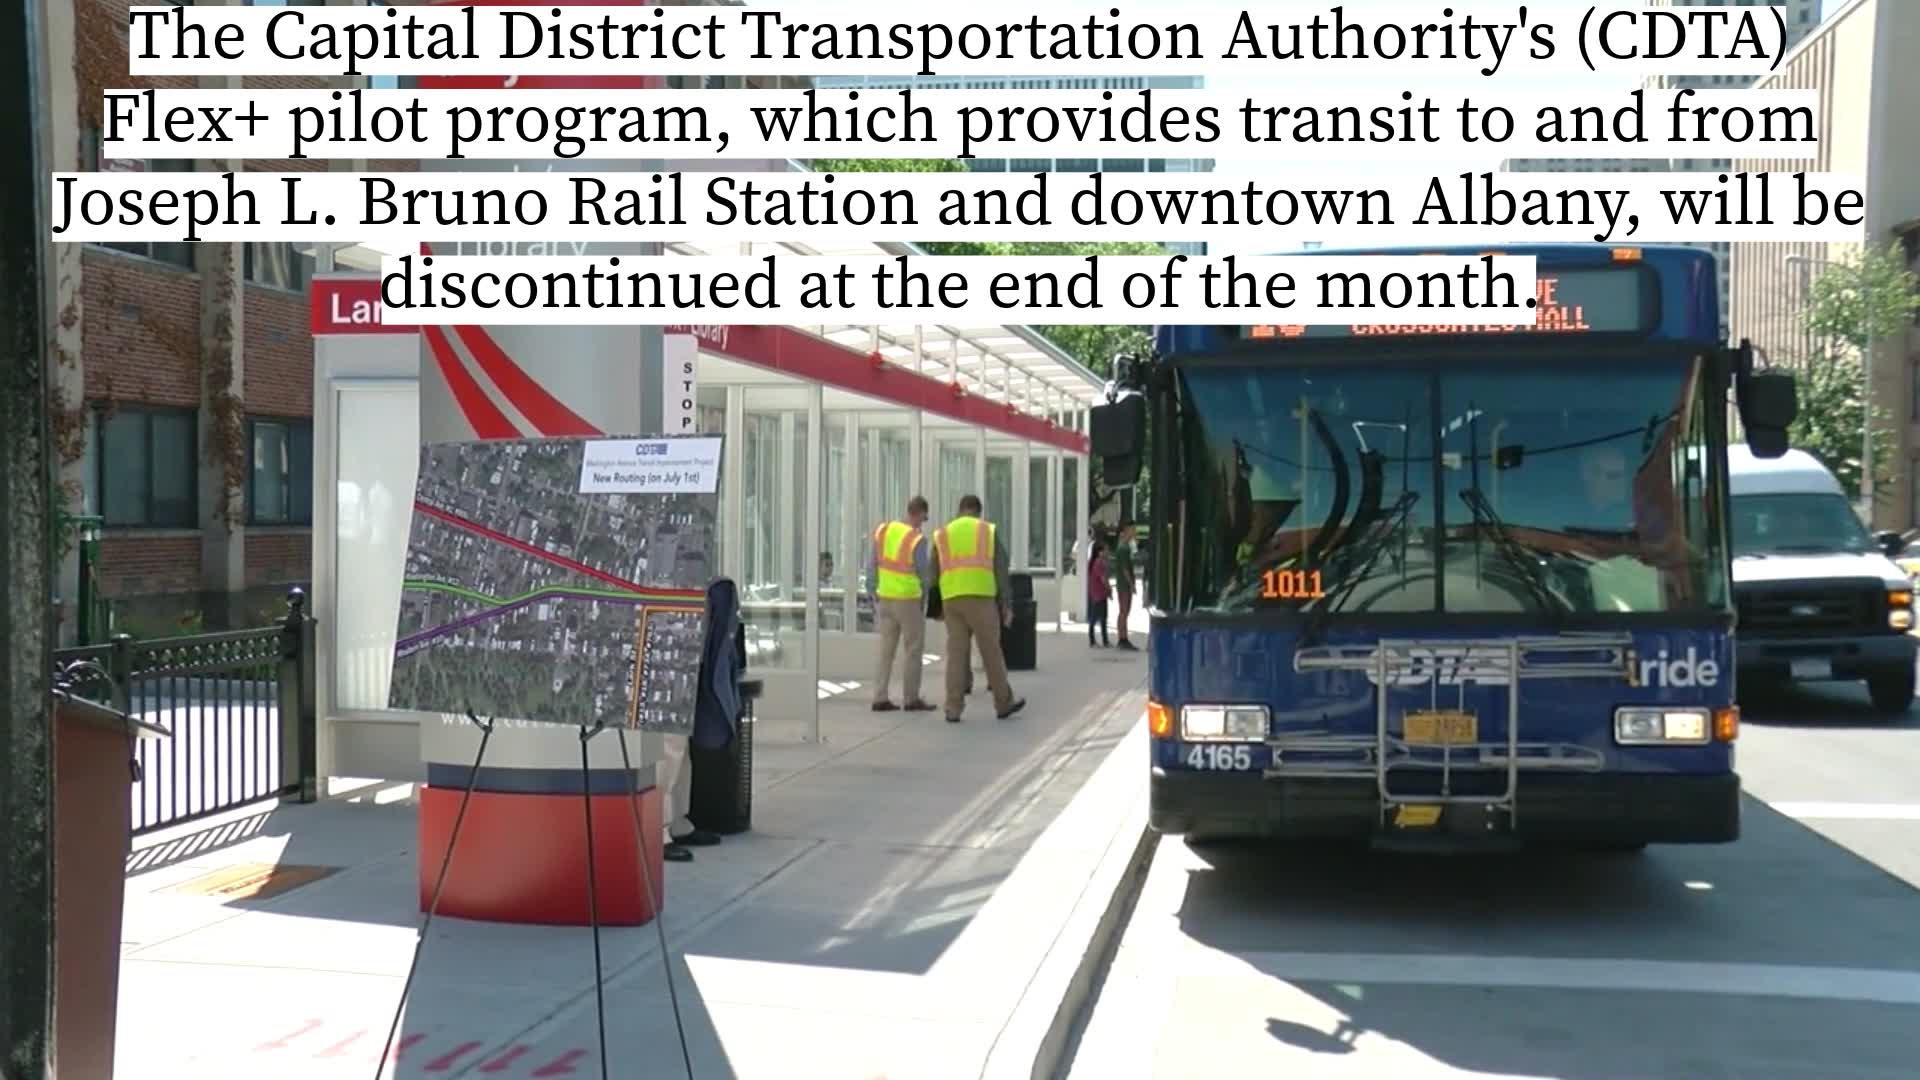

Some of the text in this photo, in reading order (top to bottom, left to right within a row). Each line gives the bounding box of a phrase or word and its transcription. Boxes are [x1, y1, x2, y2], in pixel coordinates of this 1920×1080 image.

[681, 362, 693, 428] STOP
[593, 471, 700, 486] New Routing (on July 1st)
[1262, 570, 1325, 598] 1011
[1187, 744, 1251, 770] 4165
